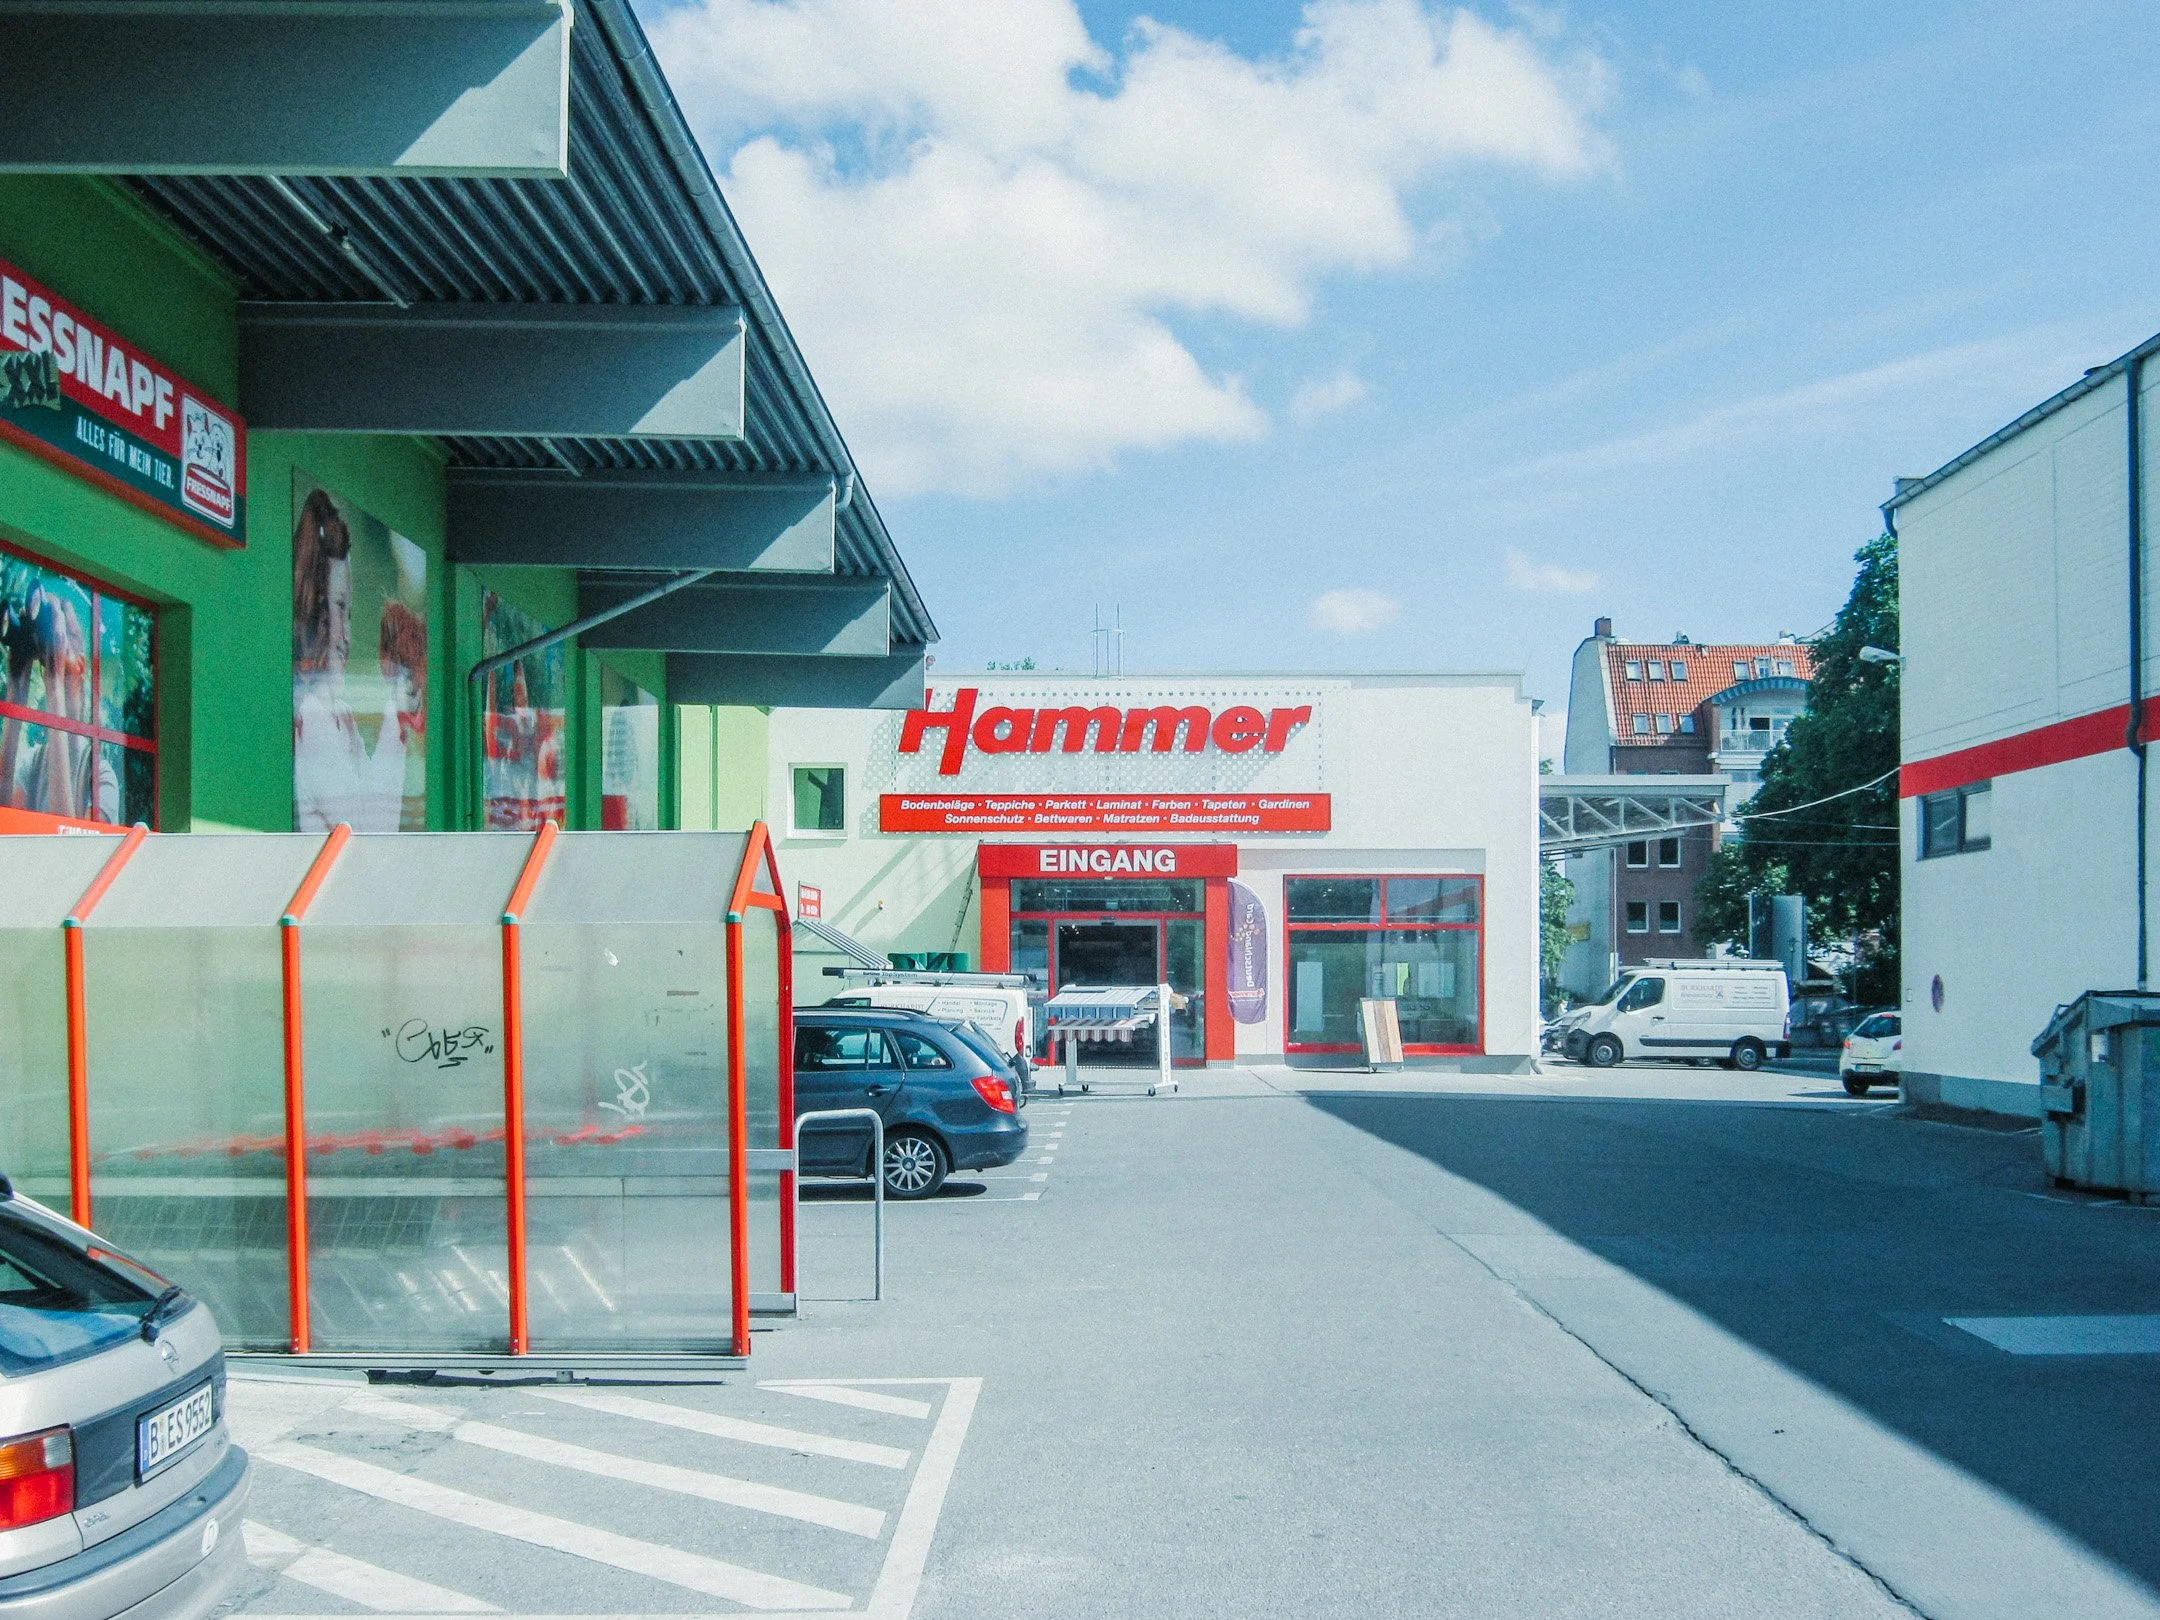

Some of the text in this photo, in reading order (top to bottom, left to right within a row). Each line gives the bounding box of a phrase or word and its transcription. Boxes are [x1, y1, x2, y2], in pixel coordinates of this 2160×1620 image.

[0, 274, 173, 430] ESSNAPF
[76, 415, 105, 452] ALLES
[108, 430, 125, 463] FÜR
[129, 444, 151, 476] MEIN
[186, 476, 231, 511] FRESSNAPF
[898, 688, 1312, 775] Hammer
[901, 800, 1310, 812] Bodenbeläge Teppiche Parkett Laminat Farben Tapeten Gardinen
[945, 814, 1260, 825] Sonnenschutz Bettwaren Matratzen Badausstattung
[1039, 849, 1177, 872] EINGANG
[150, 1391, 211, 1459] B ES 9552
